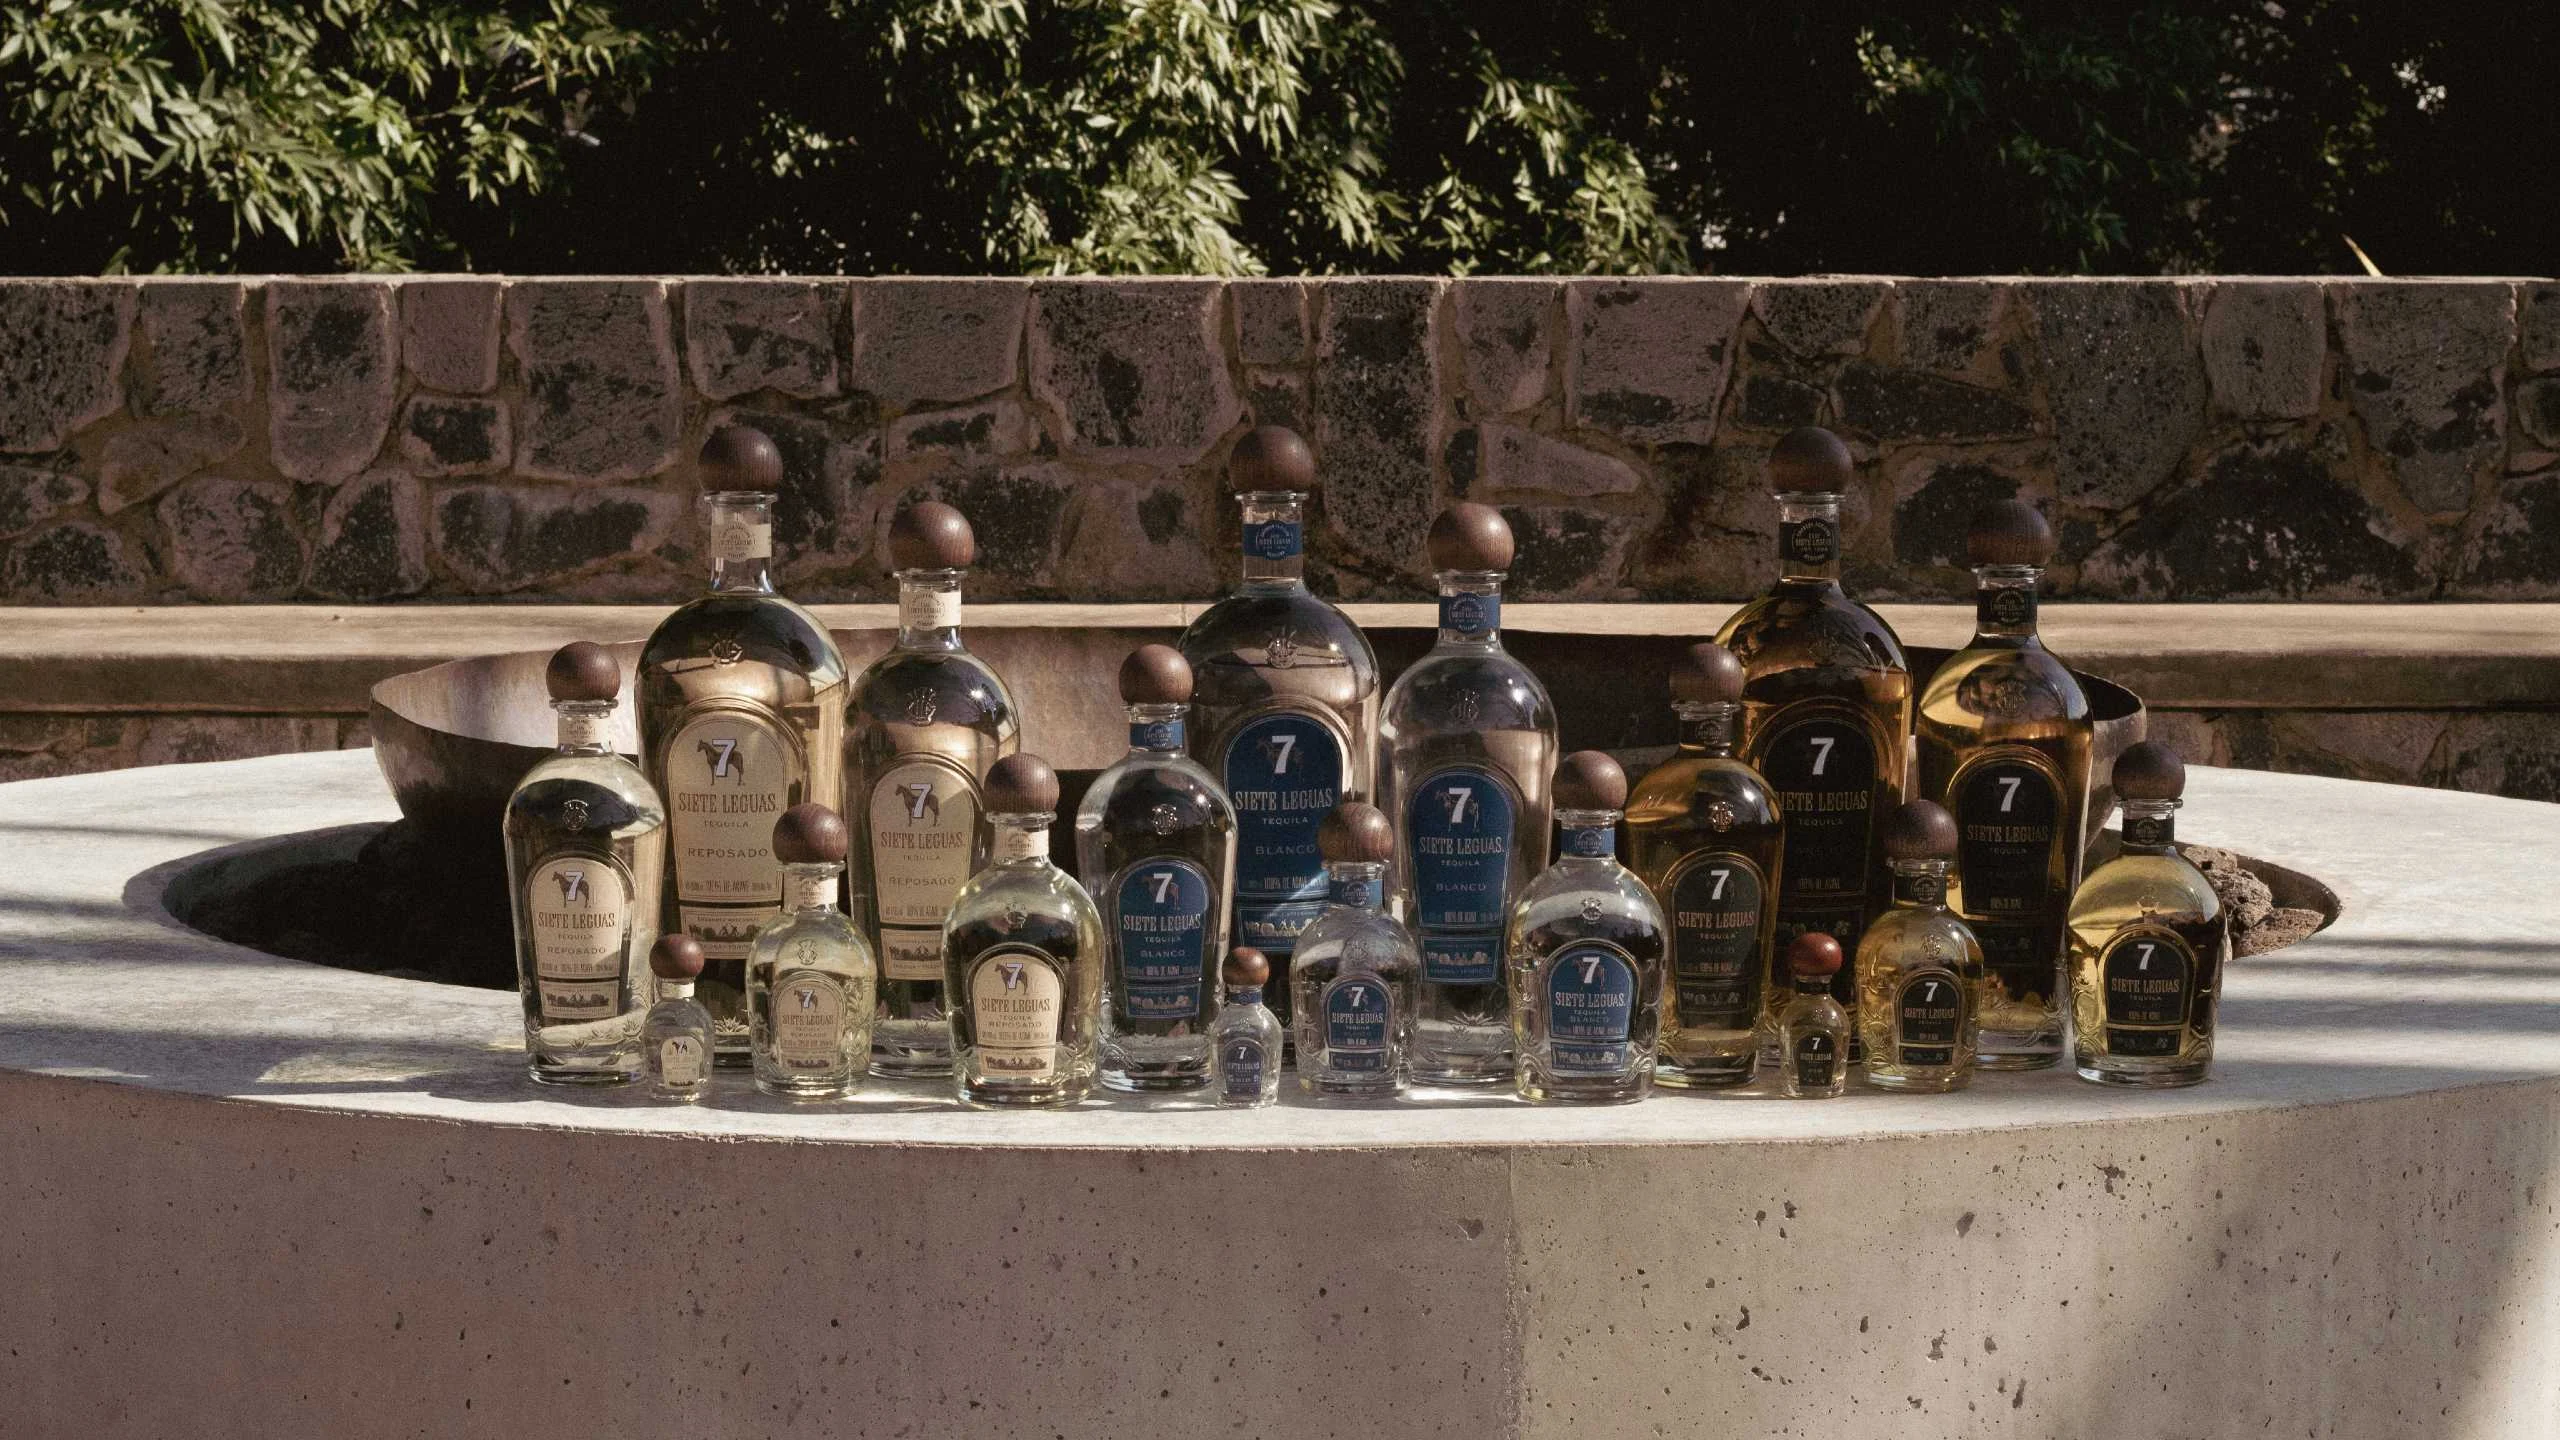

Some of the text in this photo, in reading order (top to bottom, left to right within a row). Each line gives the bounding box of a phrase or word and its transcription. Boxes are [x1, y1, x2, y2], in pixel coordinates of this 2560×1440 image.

[712, 739, 737, 777] 7
[1271, 735, 1296, 774] 7
[1810, 737, 1835, 775] 7
[679, 792, 776, 814] SIETE LEGUAS
[910, 783, 933, 819] 7
[1235, 788, 1333, 811] SIETE LEGUAS
[1776, 790, 1868, 812] IETE LEGUAS
[1999, 777, 2021, 812] 7
[1449, 787, 1472, 823] 7
[1262, 817, 1309, 825] TEQUILA
[881, 832, 963, 849] SIETE LEGUAS
[1255, 845, 1316, 856] BLANCO
[1419, 836, 1503, 855] SIETE LEGUAS
[687, 847, 768, 858] REPOSADO
[565, 871, 585, 901] 7
[889, 877, 956, 886] REPOSADO
[1153, 873, 1173, 903] 7
[1436, 883, 1487, 892] BLANCO
[1711, 870, 1729, 900] 7
[538, 912, 615, 929] SIETE LEGUAS
[1123, 913, 1201, 932] SIETE LEGUAS
[1678, 911, 1754, 928] SIETE LEGUAS
[2138, 944, 2154, 970] 7
[1006, 963, 1023, 989] 7
[1582, 957, 1600, 984] 7
[1925, 982, 1938, 1002] 7
[2111, 978, 2180, 993] SIETE LEGUAS
[801, 989, 815, 1008] 7
[981, 998, 1050, 1013] SIETE LEGUAS
[1352, 987, 1364, 1007] 7
[1555, 992, 1625, 1007] SIETE LEGUAS
[1238, 1047, 1247, 1060] 7
[1812, 1037, 1821, 1050] 7
